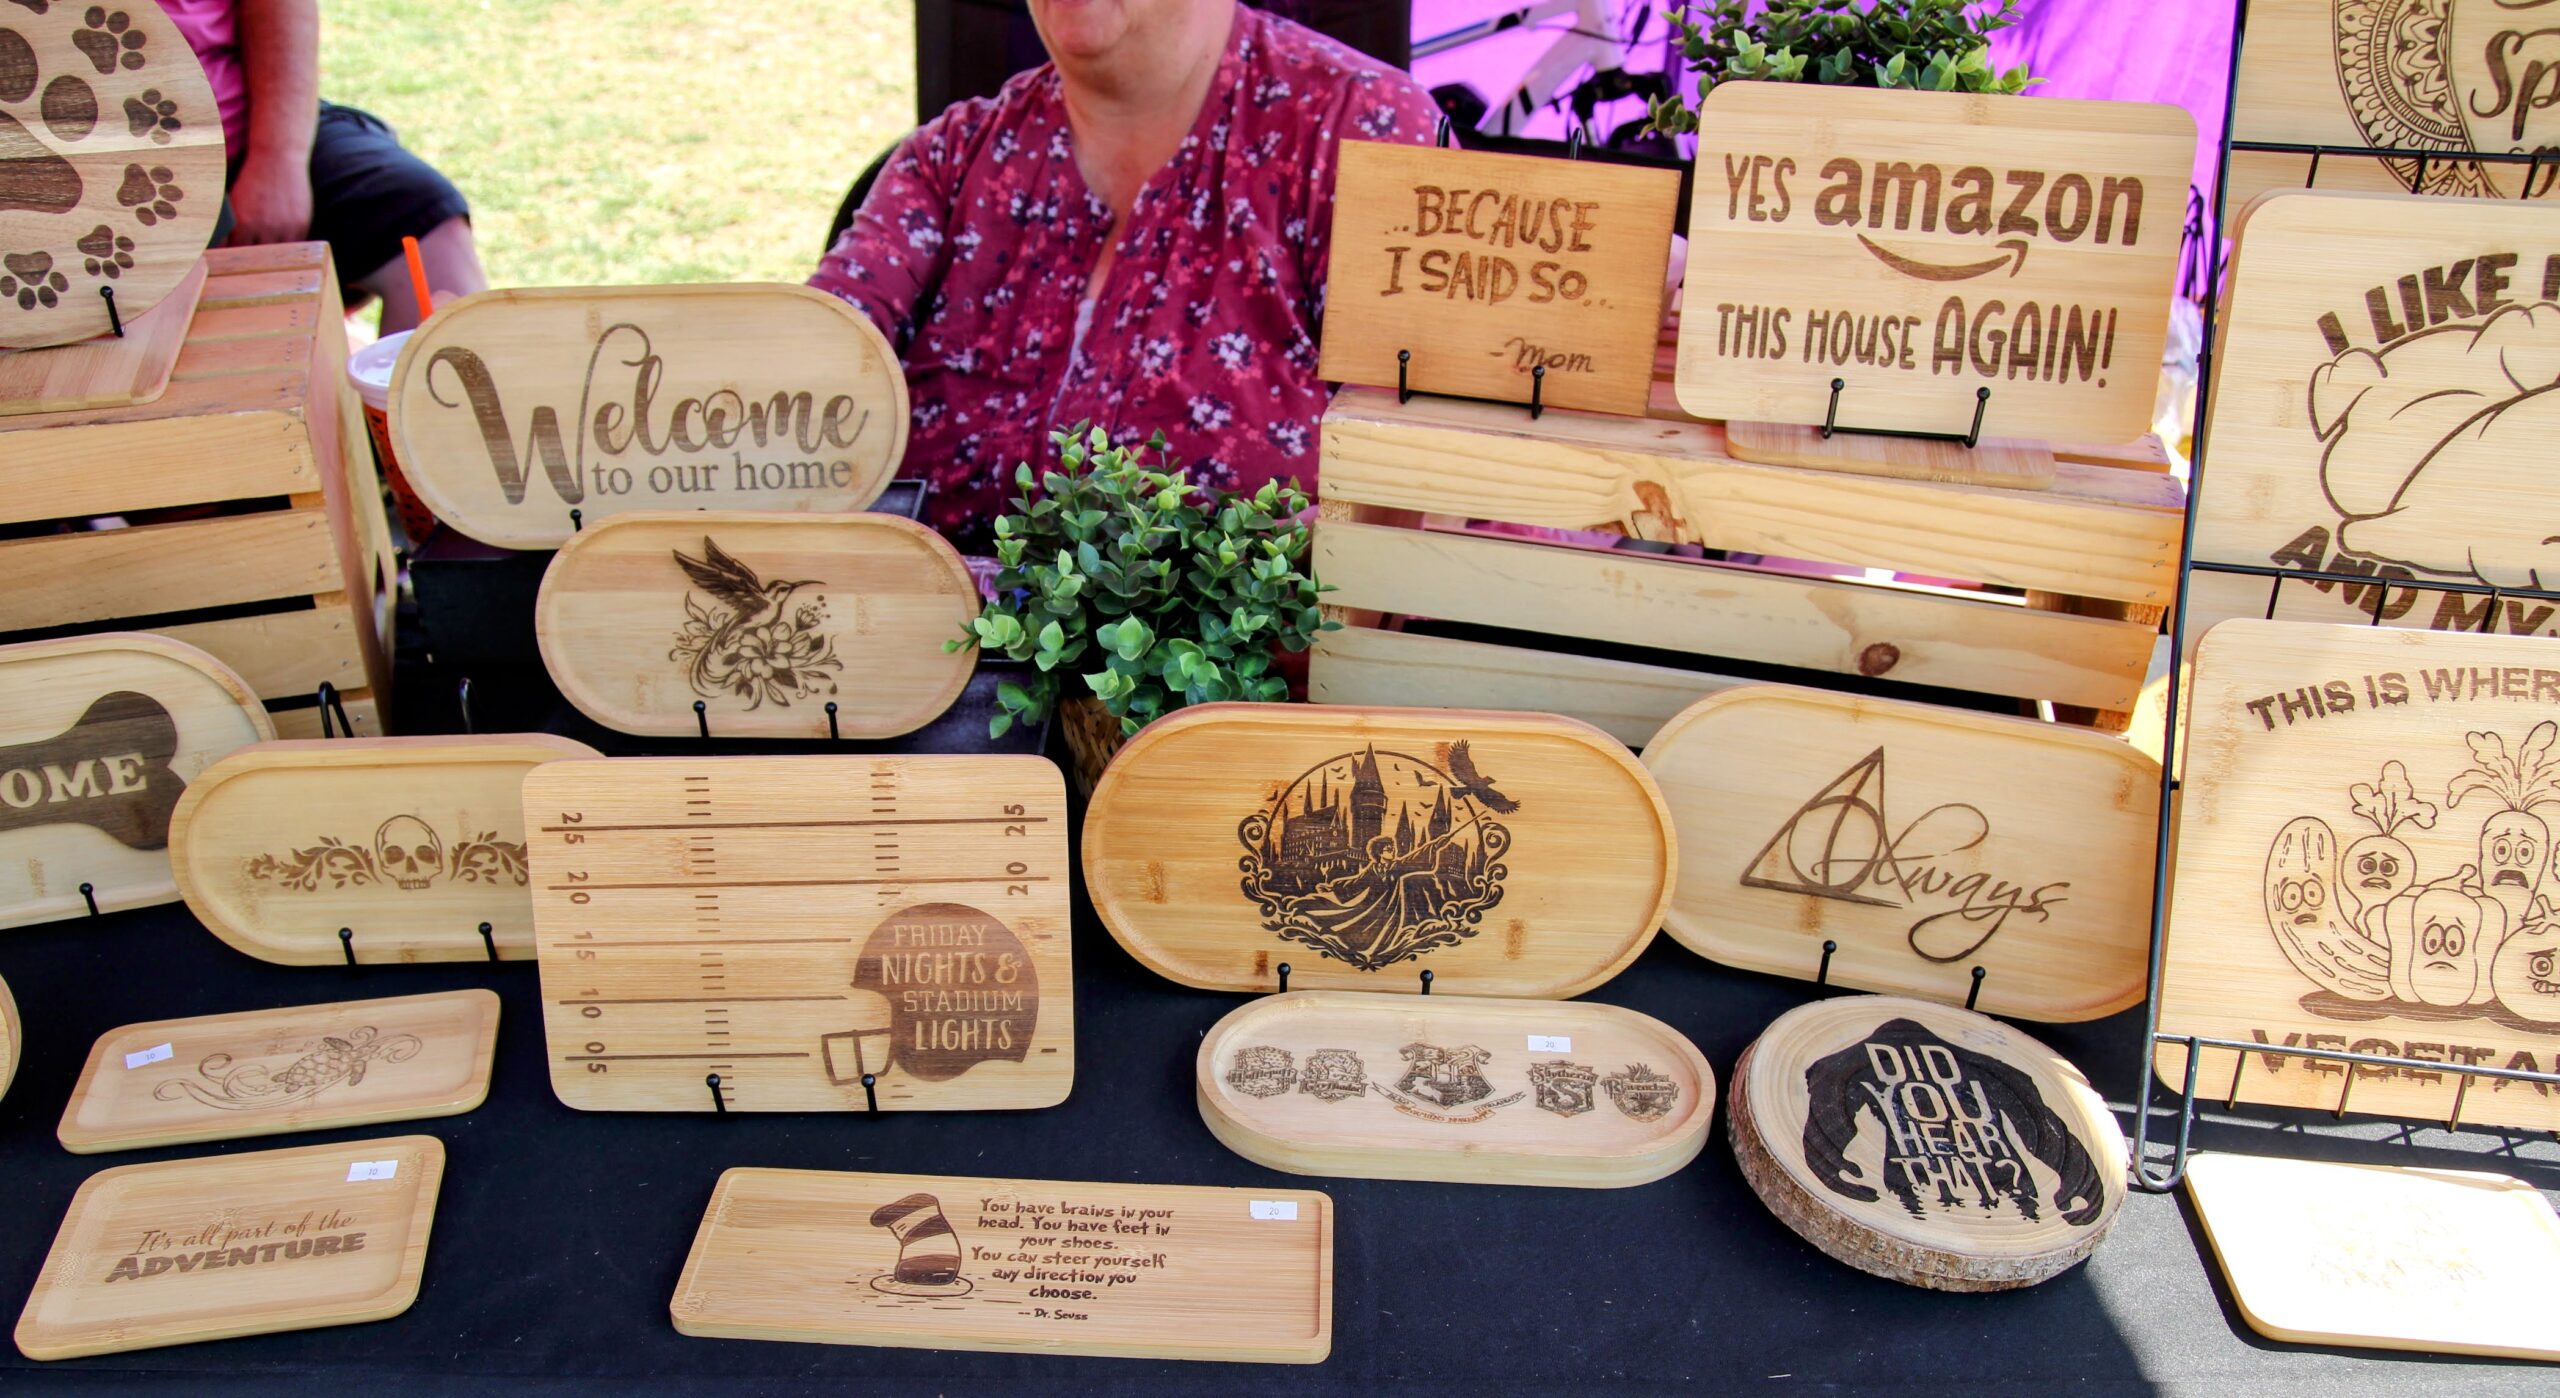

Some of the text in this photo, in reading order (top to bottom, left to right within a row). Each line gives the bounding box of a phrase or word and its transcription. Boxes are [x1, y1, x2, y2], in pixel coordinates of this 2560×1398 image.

[1725, 153, 2144, 247] YES amazon
[1380, 247, 1411, 297] I
[1419, 249, 1519, 305] SAID
[2316, 311, 2350, 357] I
[2365, 252, 2519, 344] LIKE
[1717, 296, 2118, 388] THIS HOUSE AGAIN!
[426, 323, 869, 505] Welcome
[591, 452, 852, 496] to our home
[2270, 525, 2419, 620] AND
[2246, 680, 2356, 732] THIS
[2363, 672, 2410, 709] IS
[0, 752, 147, 808] OME
[893, 924, 988, 946] FRIDAY
[881, 952, 1022, 985] NIGHTS &
[903, 990, 1023, 1012] STADIUM
[915, 1018, 1012, 1050] LIGHTS
[1545, 1040, 1555, 1049] 20
[1865, 1043, 1962, 1083] DID
[1860, 1080, 1994, 1123] YOU
[1898, 1119, 2012, 1158] HEAR
[1889, 1155, 2023, 1201] THAT?
[978, 1216, 1170, 1235] head. You have feet in
[981, 1198, 1174, 1221] You have brains in your
[127, 1208, 357, 1256] It's all part of the
[1019, 1236, 1119, 1250] your shoes.
[104, 1232, 368, 1283] ADVENTURE
[971, 1246, 1166, 1269] You can steer yourself
[992, 1265, 1136, 1287] any direction you
[1029, 1285, 1098, 1300] choose.
[1034, 1308, 1050, 1319] Dr.
[1054, 1310, 1088, 1321] Seuss
